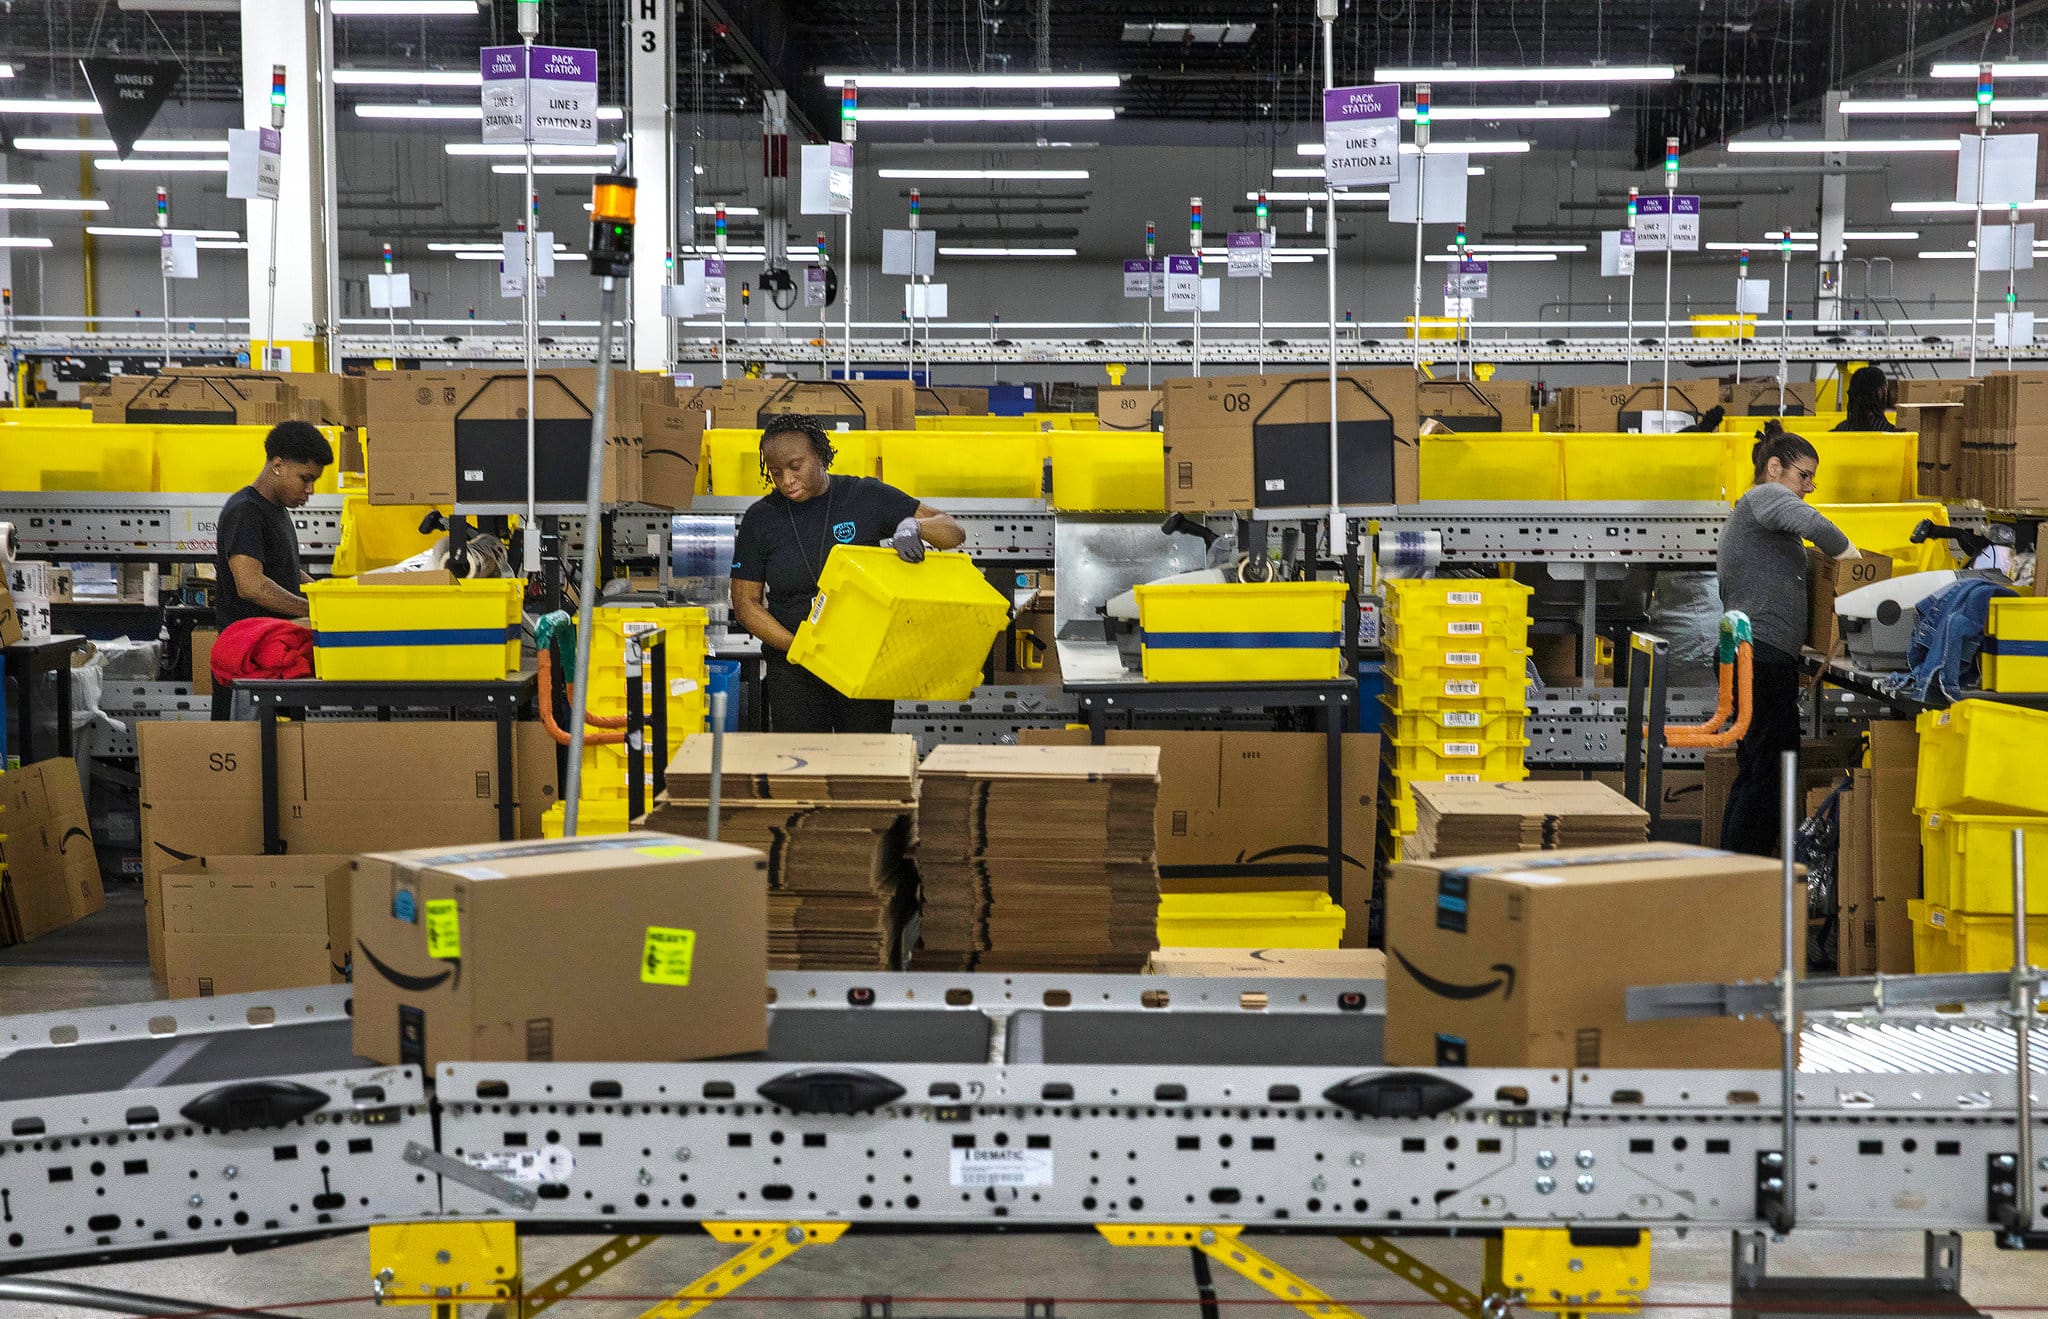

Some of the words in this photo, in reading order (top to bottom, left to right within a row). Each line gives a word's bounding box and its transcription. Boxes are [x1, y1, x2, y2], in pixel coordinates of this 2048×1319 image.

[641, 0, 656, 20] H
[641, 30, 656, 53] 3
[496, 54, 512, 63] PACK
[551, 54, 573, 65] PACK
[491, 63, 517, 74] STATION
[544, 63, 581, 75] STATION
[114, 73, 154, 86] SINGLES
[119, 88, 146, 99] PACK
[1350, 93, 1374, 104] PACK
[493, 97, 508, 108] LINE
[549, 99, 571, 111] LINE
[573, 101, 579, 111] 3
[1342, 104, 1381, 115] STATION
[485, 115, 514, 127] STATION
[536, 116, 578, 129] STATION
[580, 119, 592, 130] 23
[1346, 139, 1368, 149] LINE
[1370, 138, 1377, 148] 3
[1332, 157, 1377, 168] STATION
[1379, 155, 1392, 166] 21
[1179, 258, 1190, 266] PACK
[1175, 264, 1193, 272] STATION
[1120, 399, 1136, 409] 80
[1852, 563, 1876, 582] 90
[209, 752, 237, 772] S5
